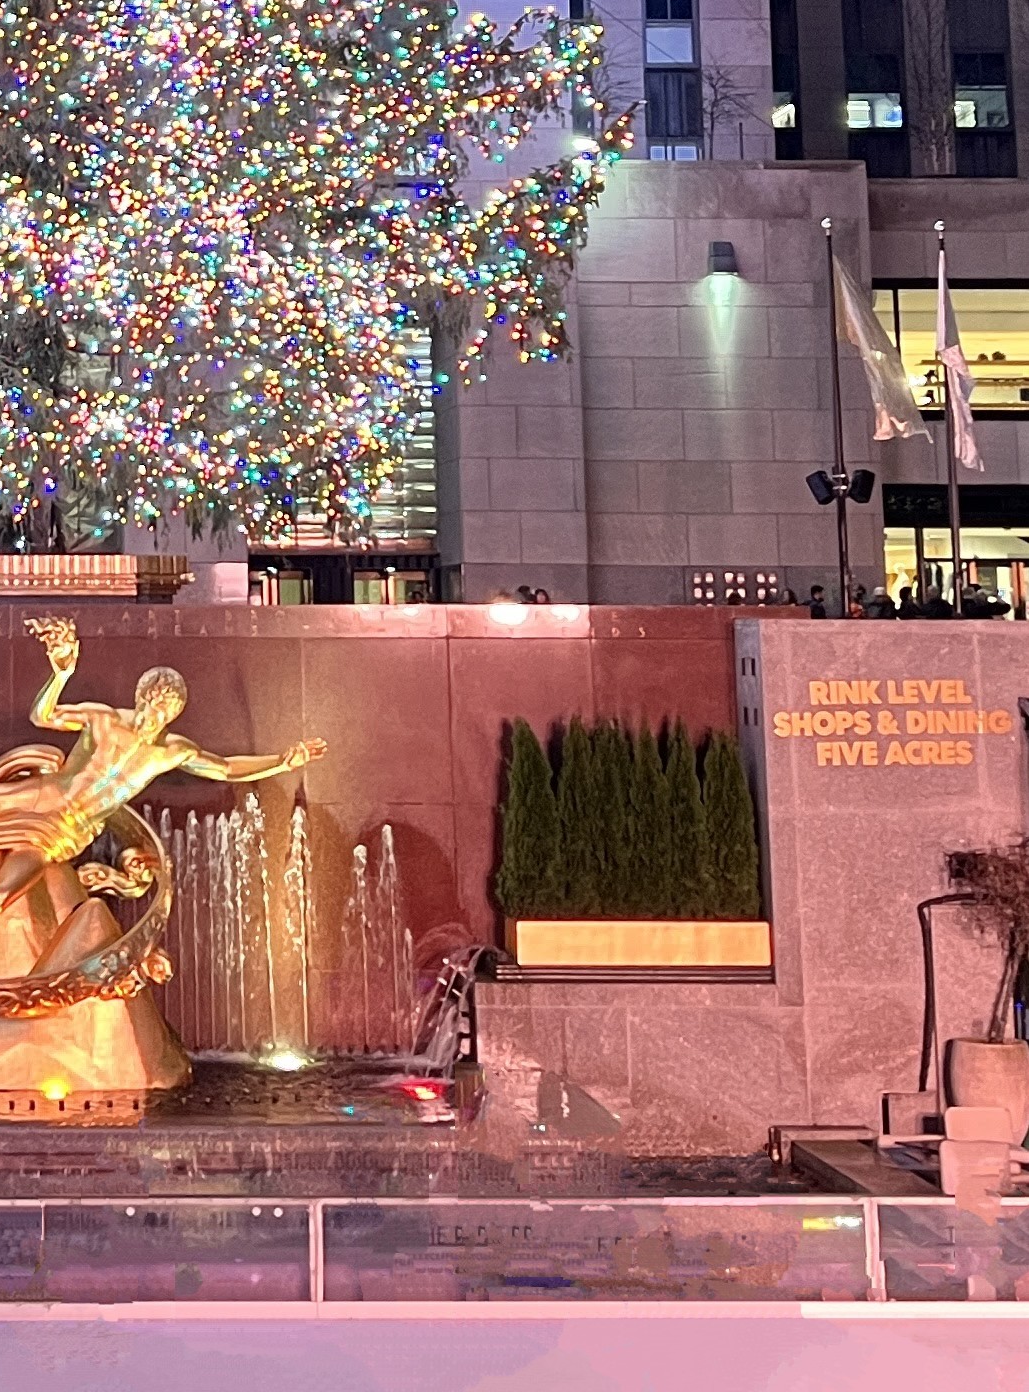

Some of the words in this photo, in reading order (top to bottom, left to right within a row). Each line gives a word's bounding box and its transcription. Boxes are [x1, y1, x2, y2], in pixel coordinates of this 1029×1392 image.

[809, 680, 882, 705] RINK
[887, 679, 972, 704] LEVEL
[773, 710, 871, 737] SHOPS
[877, 711, 901, 735] &
[906, 710, 1012, 735] DINING
[817, 741, 878, 766] FIVE
[884, 740, 974, 766] ACRES
